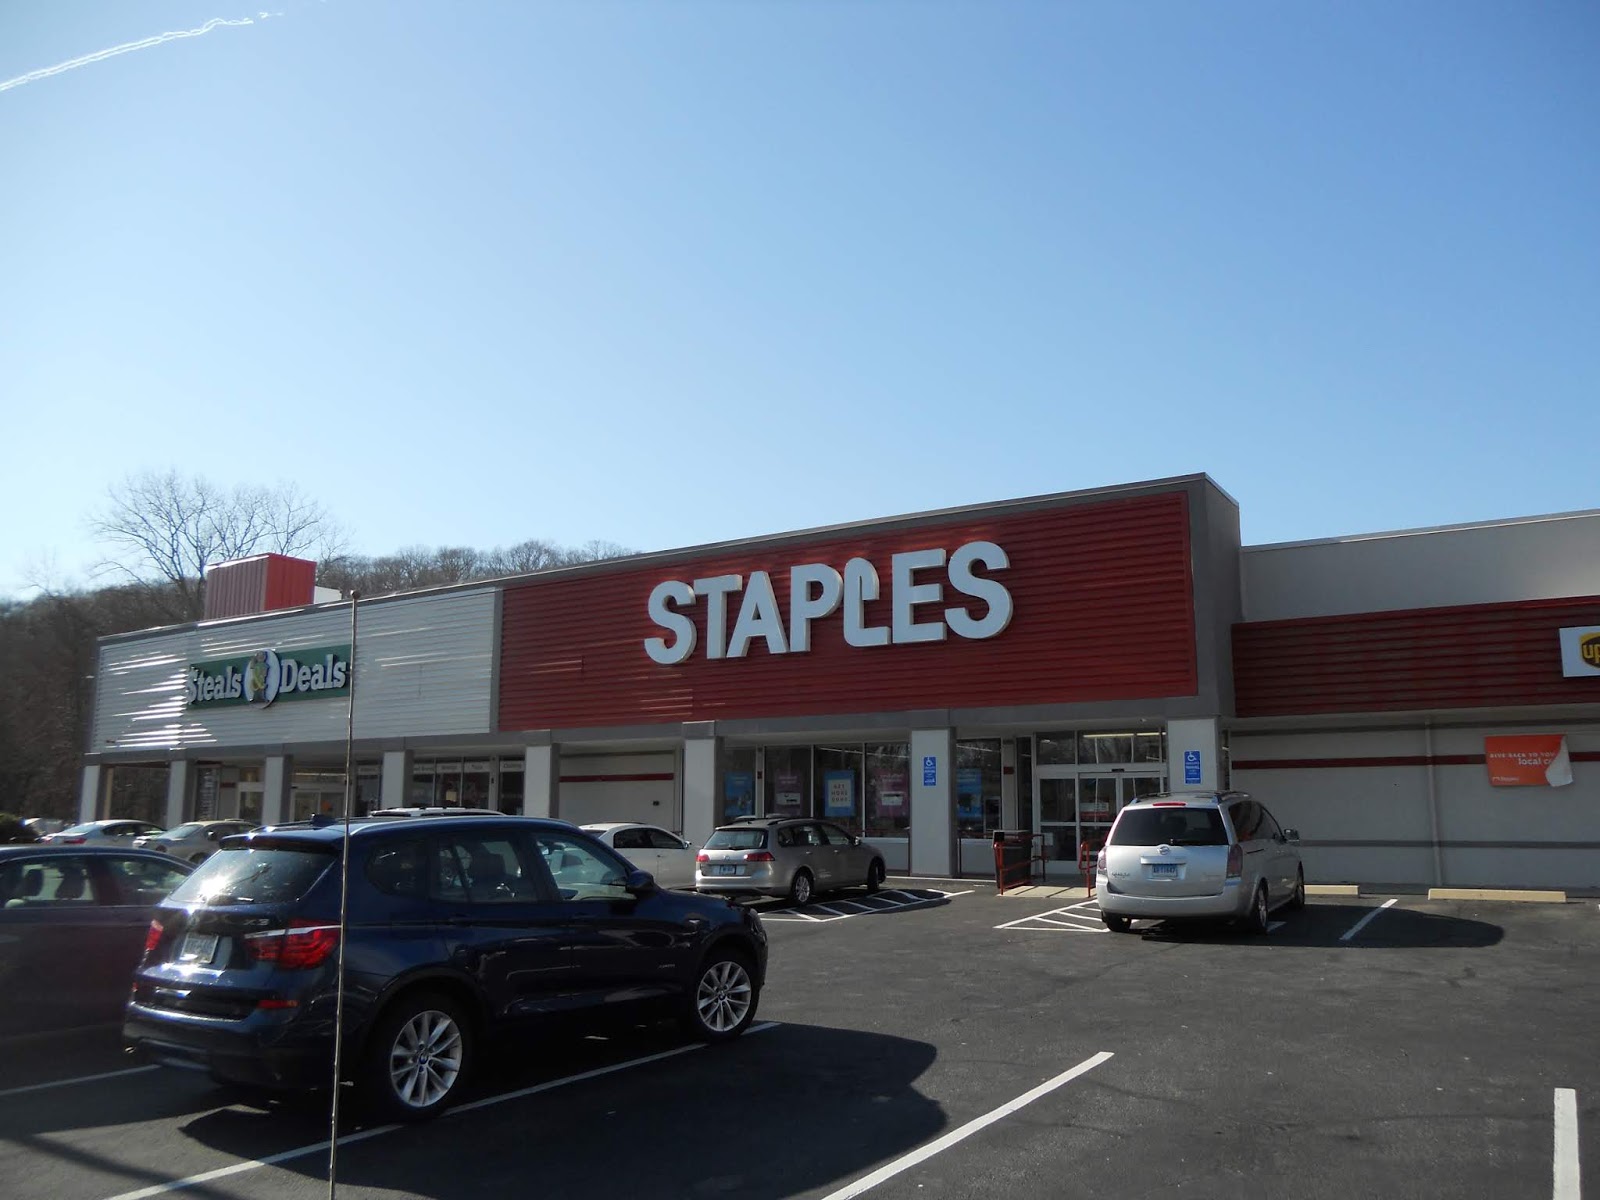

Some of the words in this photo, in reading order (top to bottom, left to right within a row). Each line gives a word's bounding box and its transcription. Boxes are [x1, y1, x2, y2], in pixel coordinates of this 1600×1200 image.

[644, 541, 1013, 665] STAPLES
[279, 653, 347, 693] Deals
[1582, 644, 1600, 664] up
